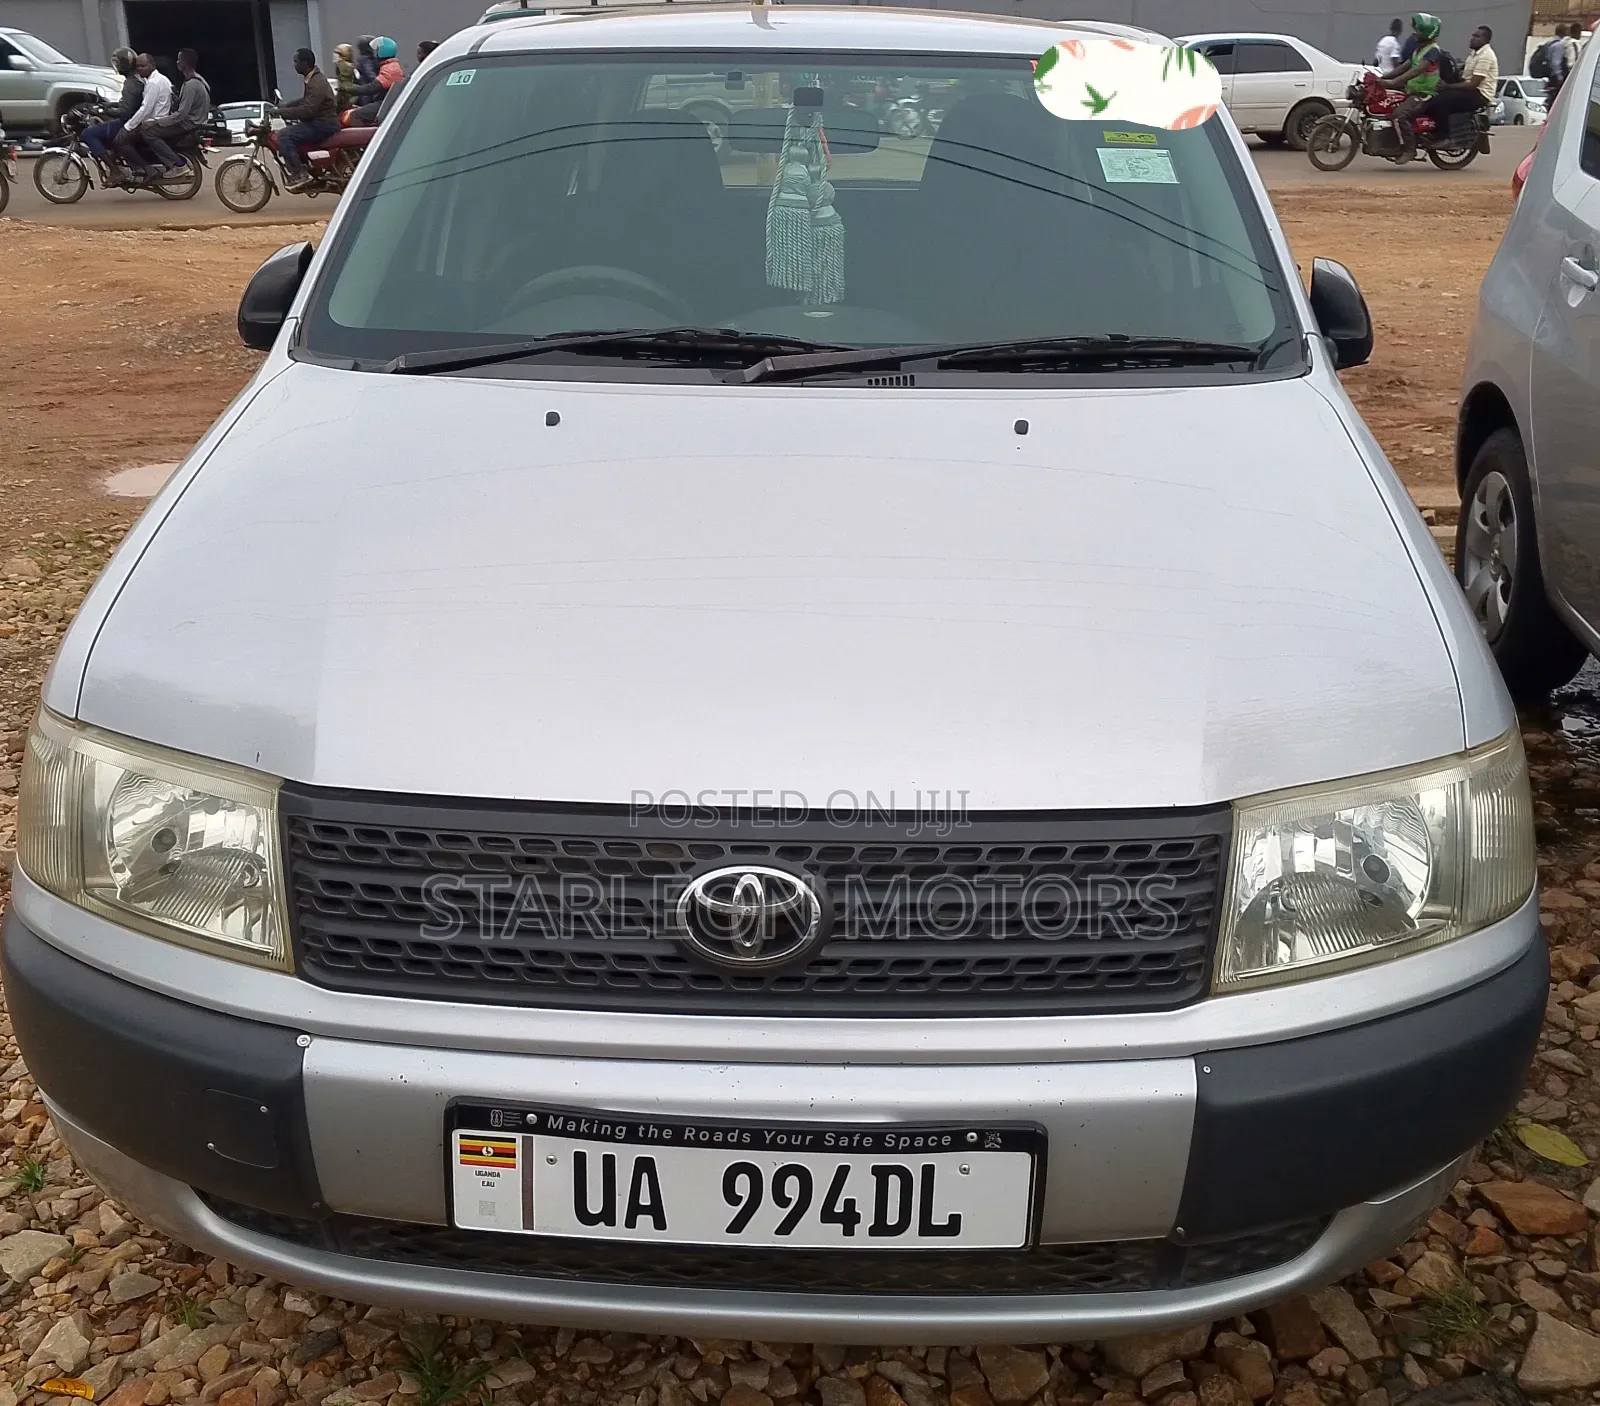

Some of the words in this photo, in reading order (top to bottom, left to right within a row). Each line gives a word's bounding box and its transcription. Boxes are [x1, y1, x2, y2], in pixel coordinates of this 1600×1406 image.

[455, 74, 472, 84] 10
[547, 1115, 627, 1140] Making
[638, 1125, 673, 1139] the
[684, 1127, 752, 1143] Roads
[763, 1130, 814, 1146] Your
[824, 1133, 873, 1147] Safe
[884, 1133, 952, 1150] Space
[474, 1170, 501, 1179] UGANDA
[481, 1180, 496, 1188] EAU
[573, 1151, 667, 1231] UA
[722, 1161, 962, 1237] 994DL
